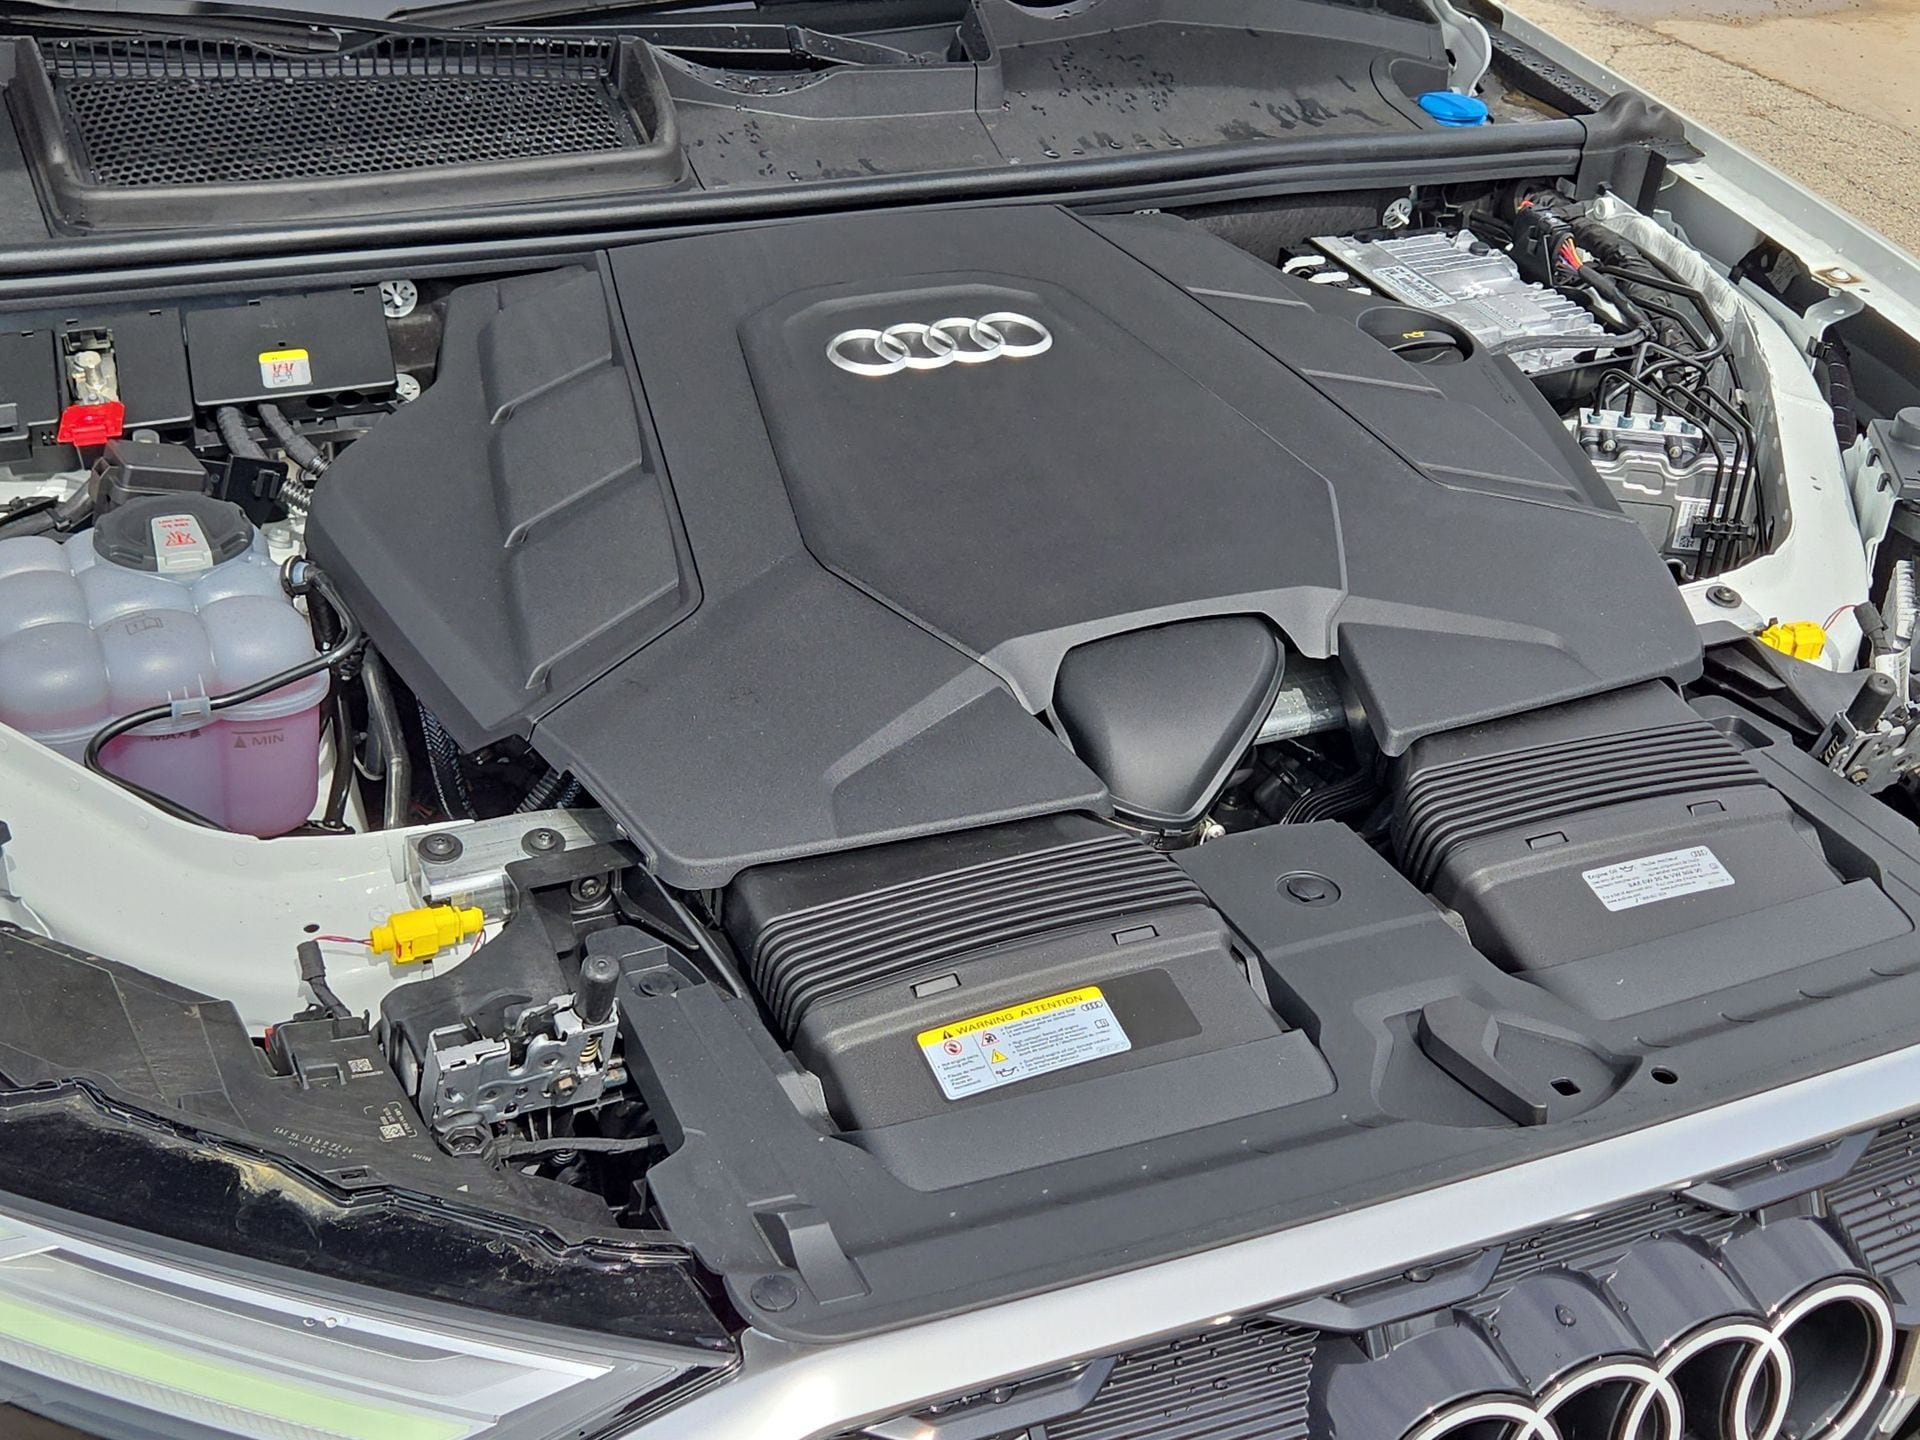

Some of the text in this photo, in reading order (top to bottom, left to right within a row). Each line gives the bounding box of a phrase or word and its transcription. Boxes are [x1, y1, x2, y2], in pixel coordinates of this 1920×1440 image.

[252, 734, 285, 746] MIN
[956, 1013, 1015, 1036] WARNING
[1020, 995, 1083, 1018] ATTENTION
